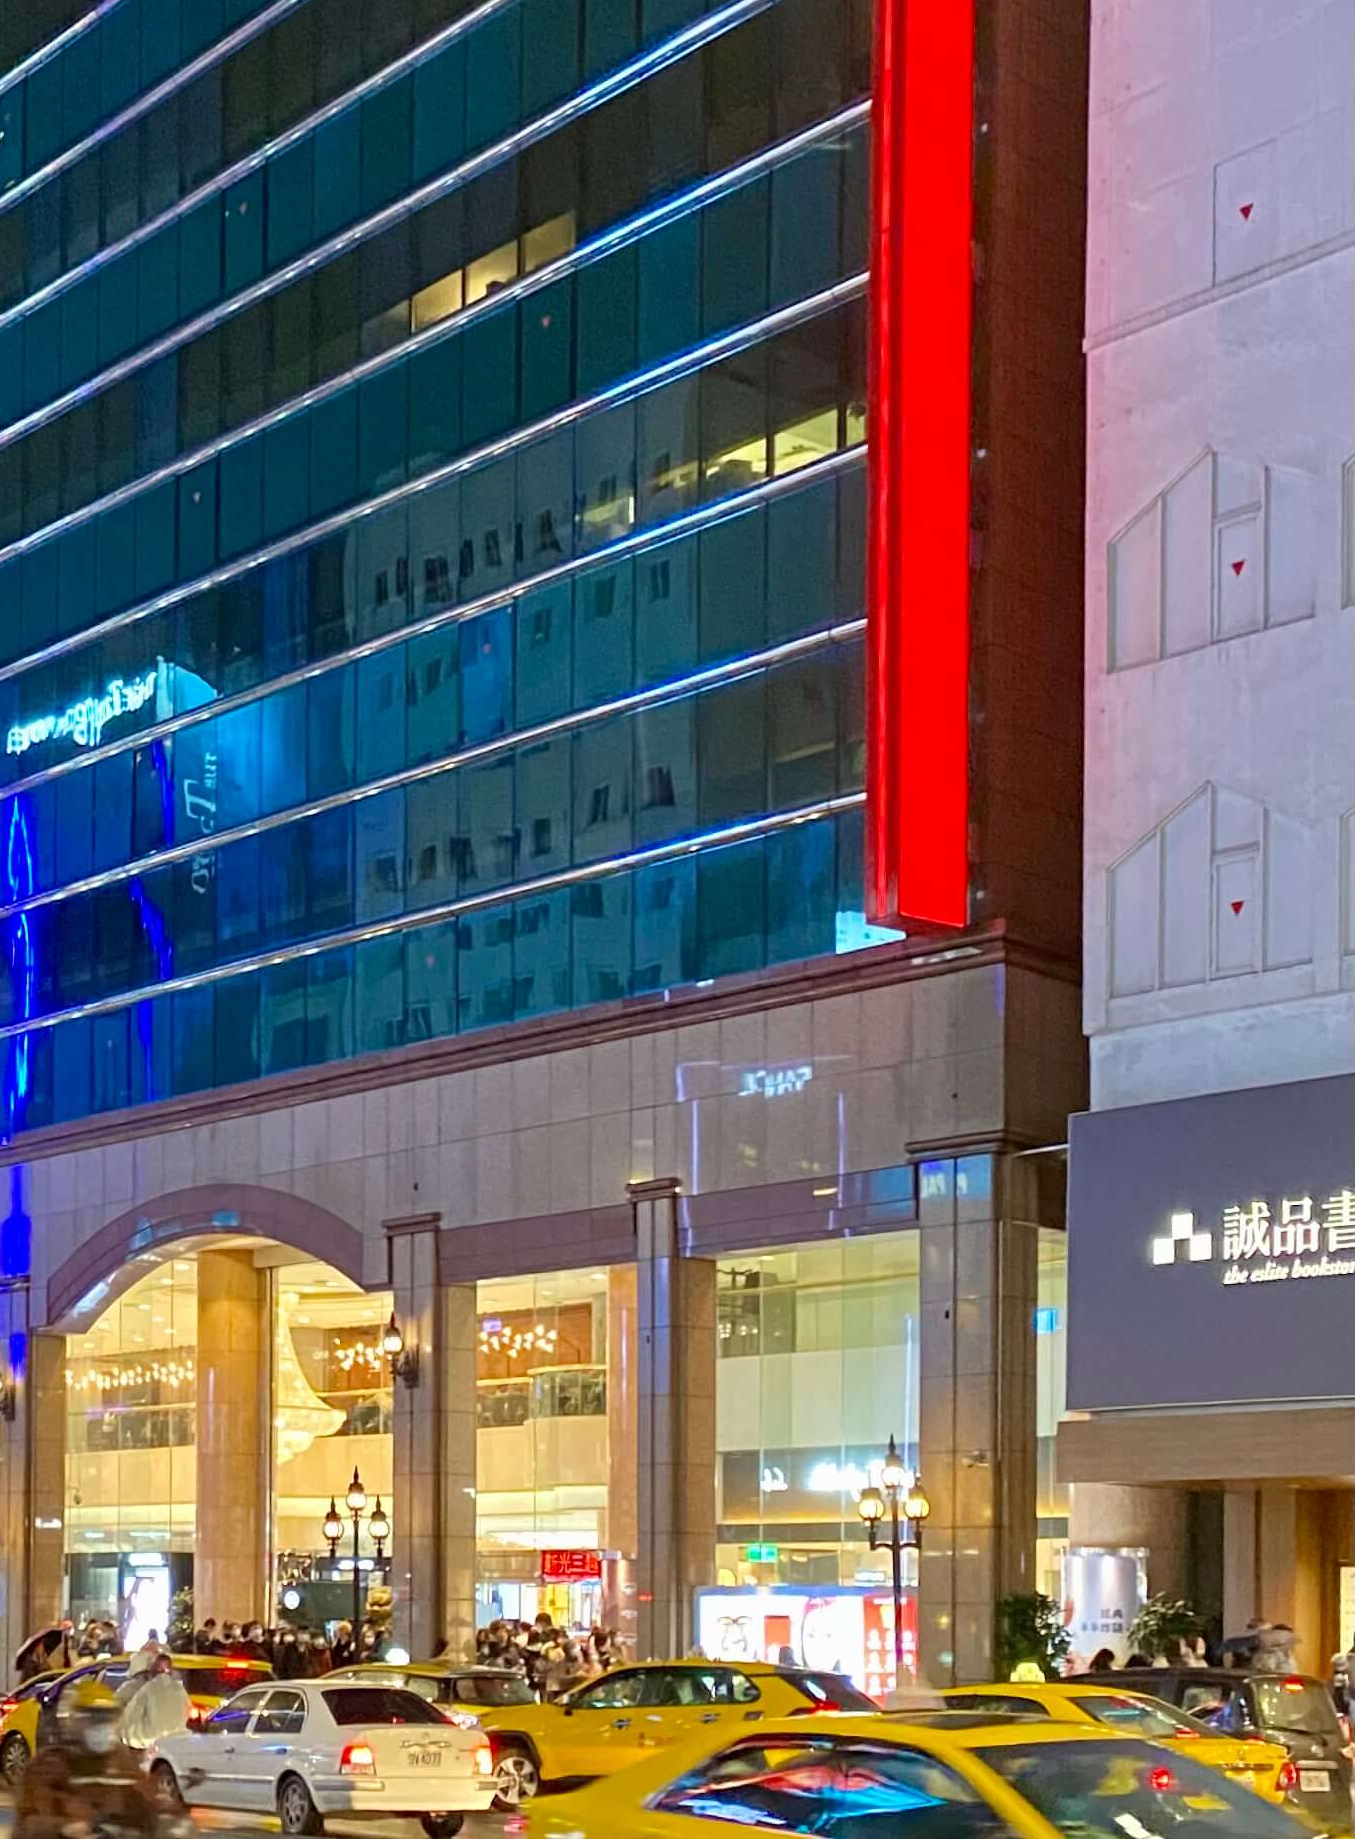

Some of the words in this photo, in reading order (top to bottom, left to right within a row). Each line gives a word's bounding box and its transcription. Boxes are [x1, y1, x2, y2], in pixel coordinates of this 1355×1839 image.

[1223, 1190, 1355, 1261] 誠品書
[1223, 1264, 1249, 1285] the
[1251, 1262, 1289, 1283] eslite
